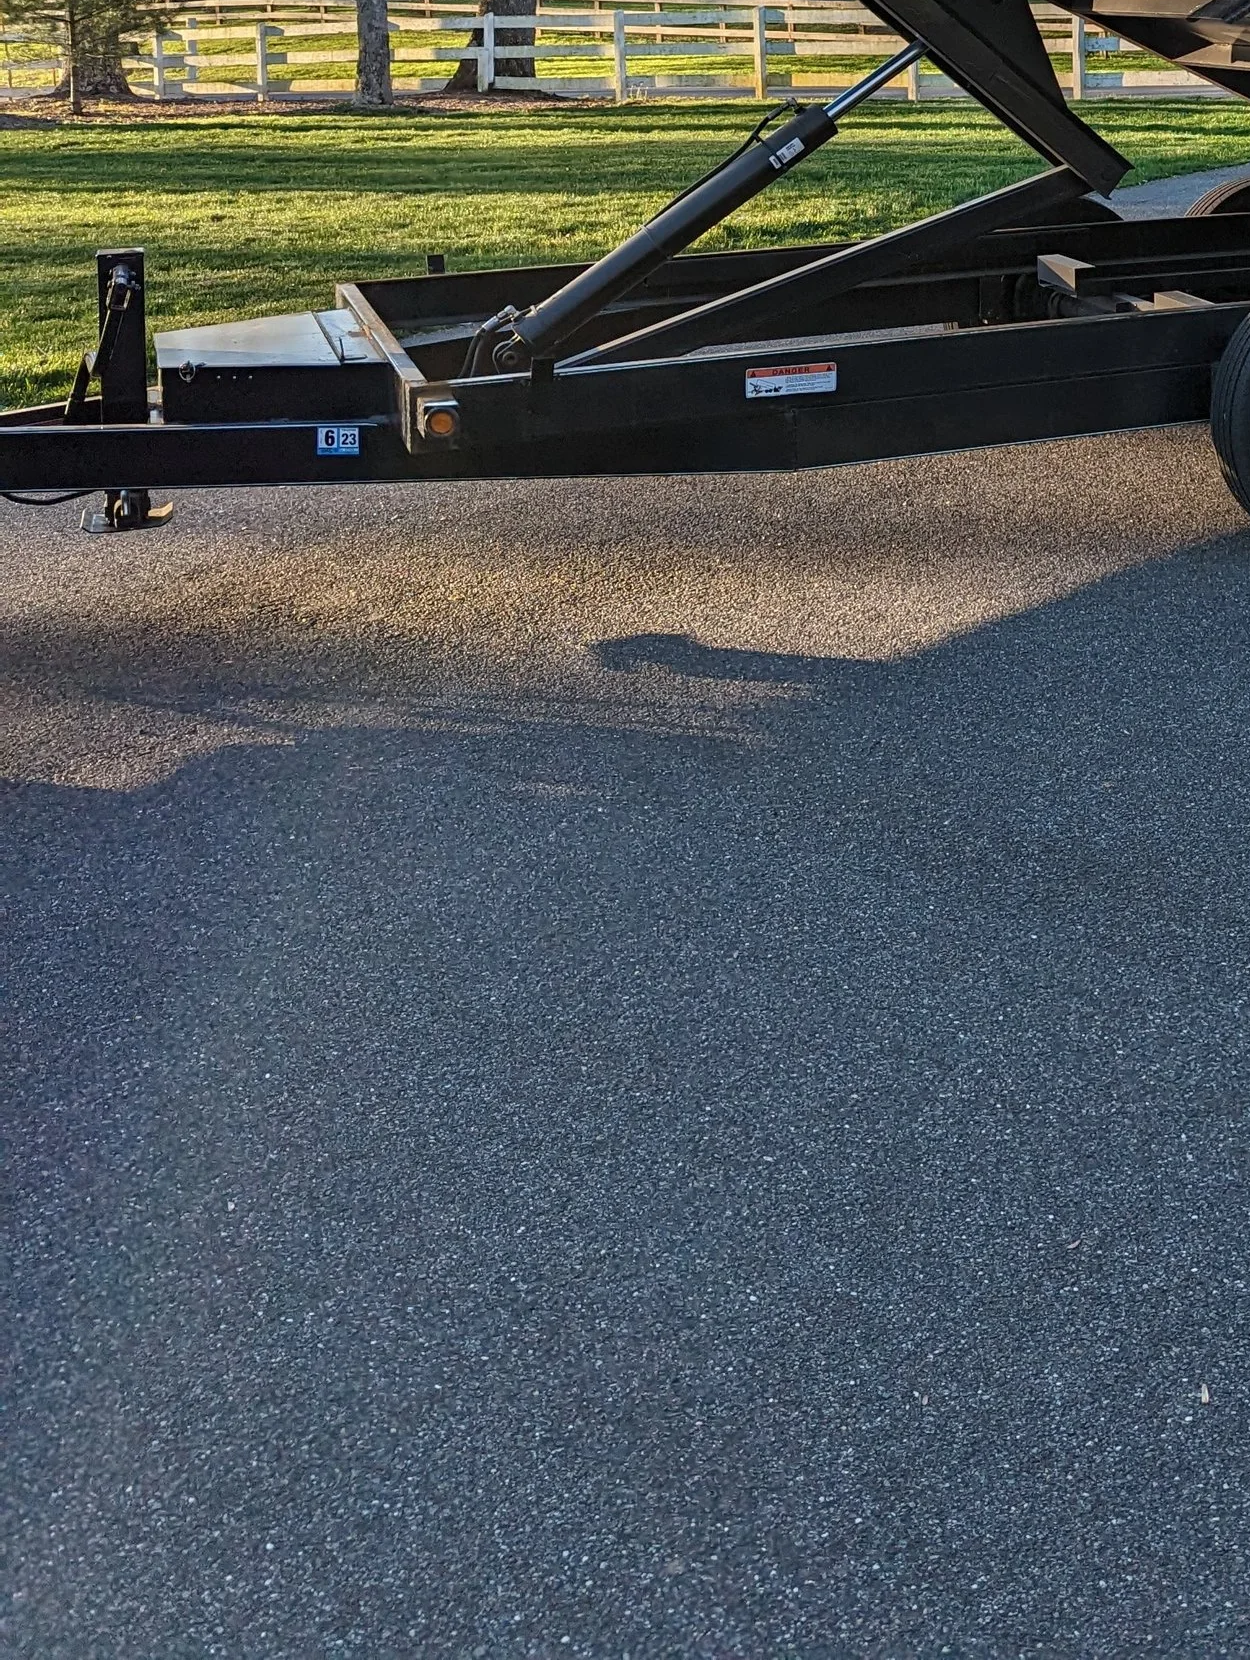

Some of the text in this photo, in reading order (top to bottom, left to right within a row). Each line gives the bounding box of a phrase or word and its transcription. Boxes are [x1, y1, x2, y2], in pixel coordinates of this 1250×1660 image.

[772, 367, 810, 375] DANGER
[324, 429, 357, 446] 6 23
